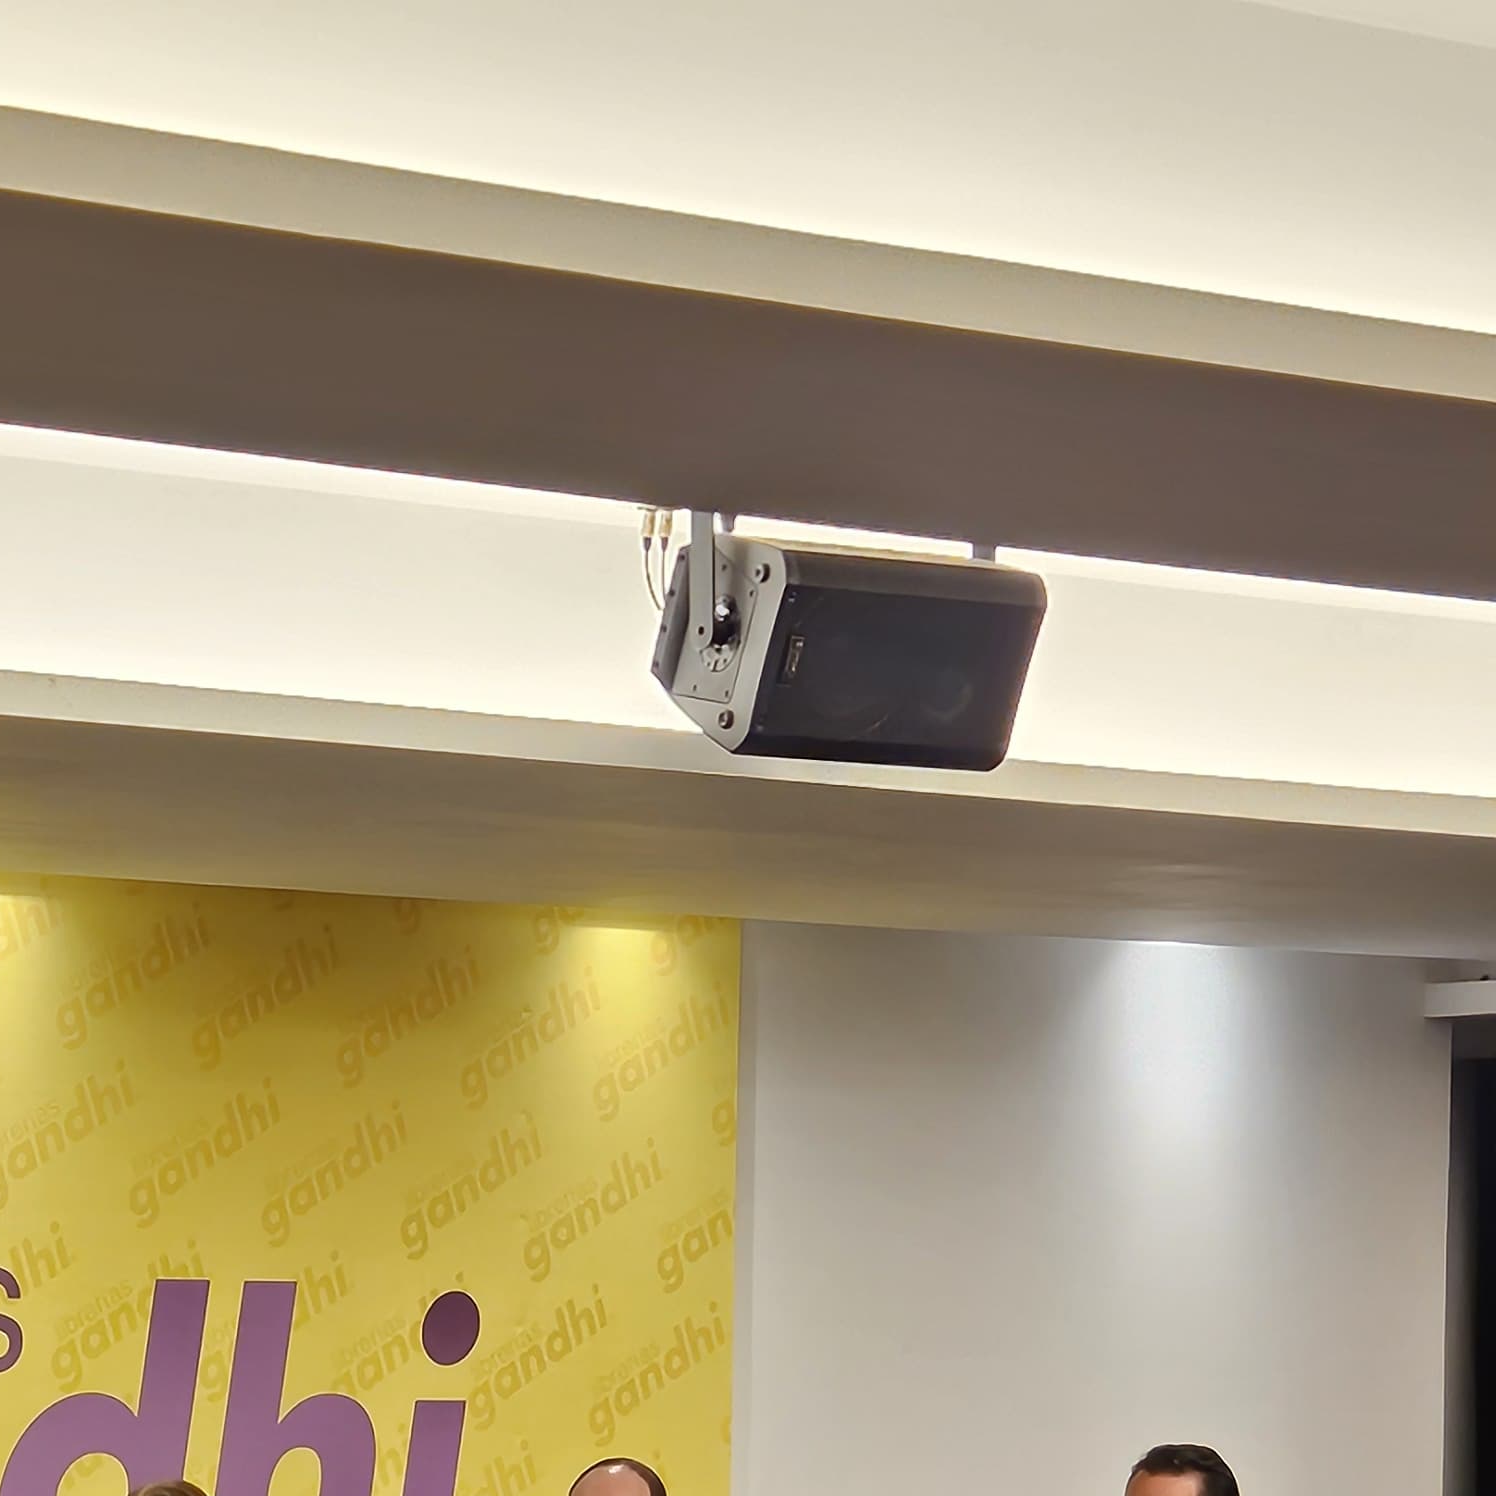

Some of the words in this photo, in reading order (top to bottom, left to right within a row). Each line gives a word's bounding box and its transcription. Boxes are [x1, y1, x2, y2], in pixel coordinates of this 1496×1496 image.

[461, 964, 600, 1112] gandhi
[593, 980, 729, 1123] gandhi
[129, 1075, 281, 1229] gandhi
[261, 1098, 407, 1247] gandhi
[400, 1109, 542, 1260] gandhi
[523, 1137, 663, 1283] gandhi
[657, 1207, 733, 1295] gan
[468, 1282, 607, 1431] gandhi
[588, 1300, 725, 1448] gandhi
